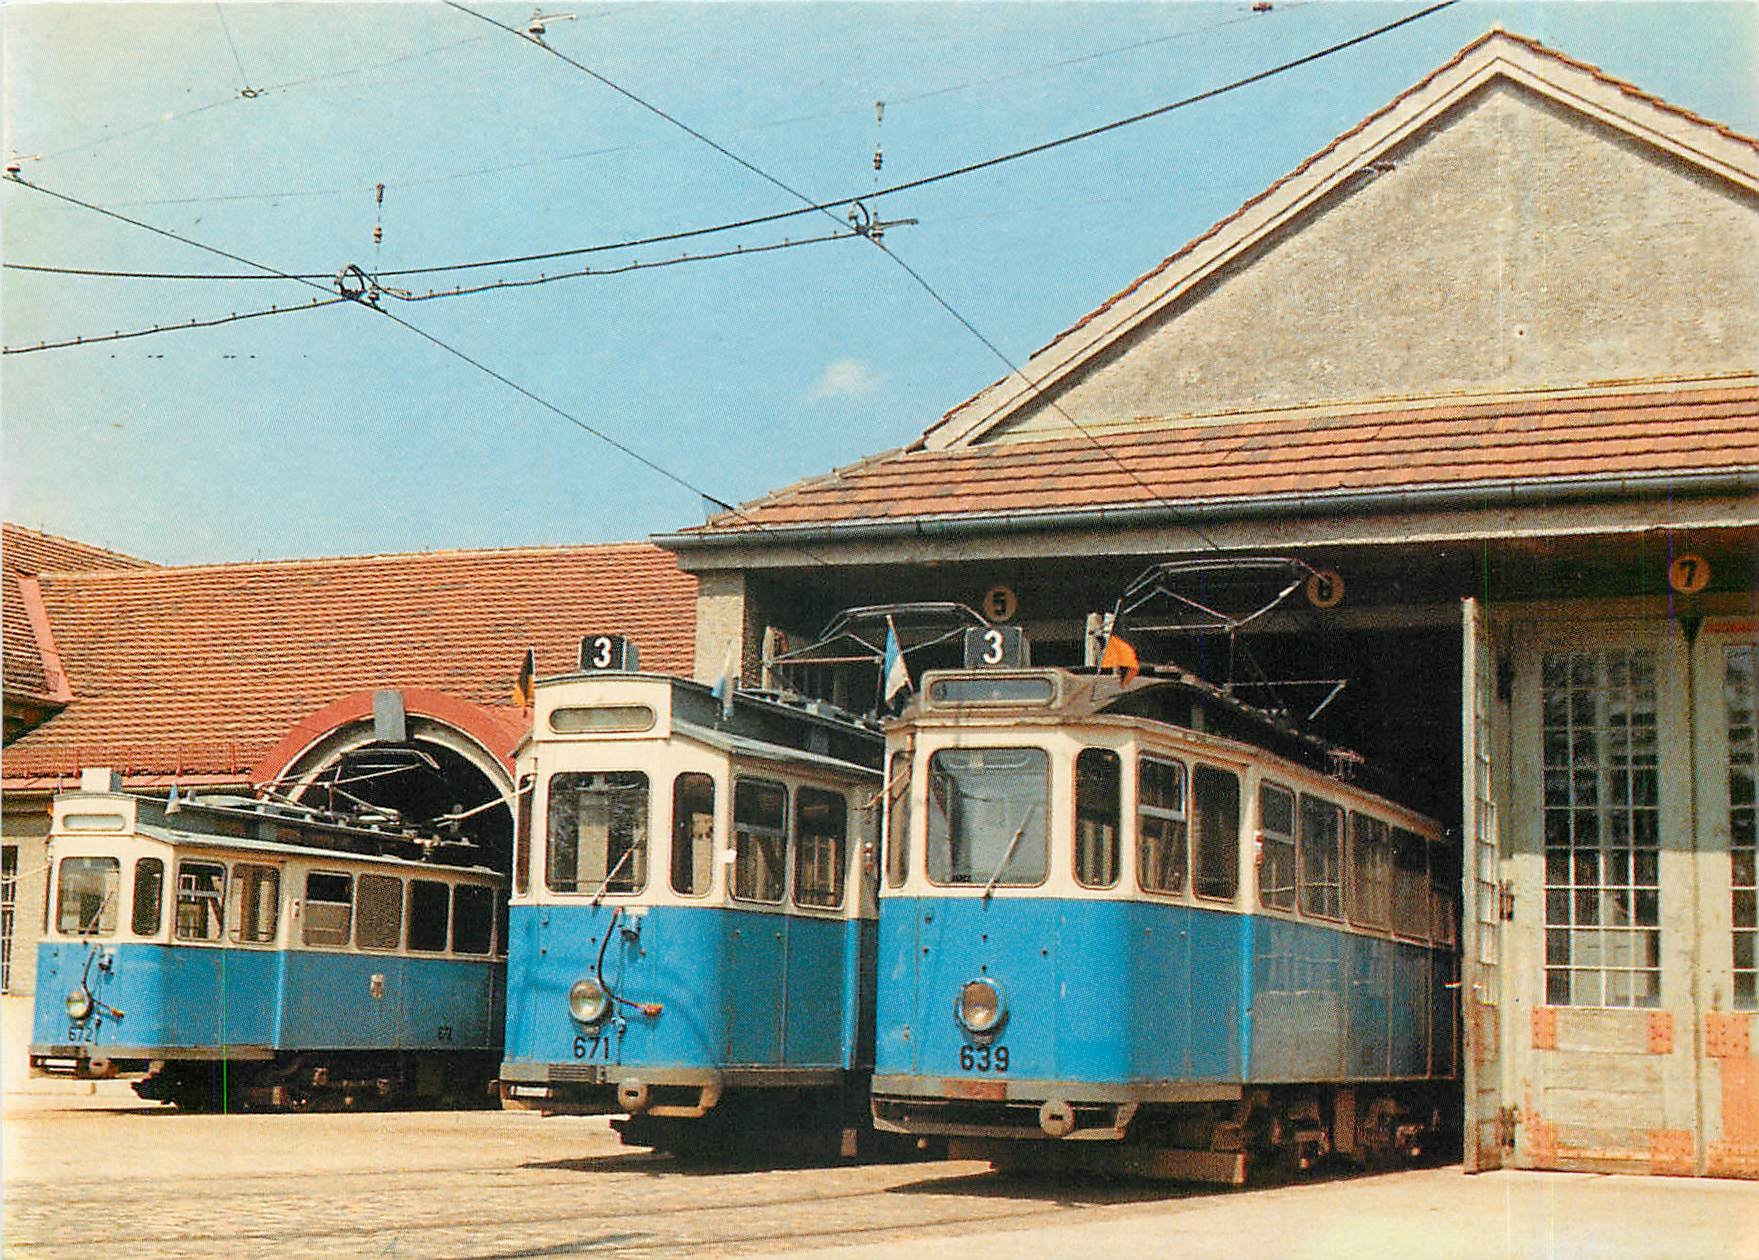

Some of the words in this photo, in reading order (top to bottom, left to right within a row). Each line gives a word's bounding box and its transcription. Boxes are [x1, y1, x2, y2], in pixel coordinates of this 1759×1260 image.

[1680, 560, 1697, 587] 7
[993, 591, 1007, 615] 5
[594, 636, 611, 668] 3
[984, 630, 1004, 664] 3
[68, 1025, 92, 1042] 672
[573, 1036, 609, 1059] 671
[960, 1044, 1009, 1072] 639
